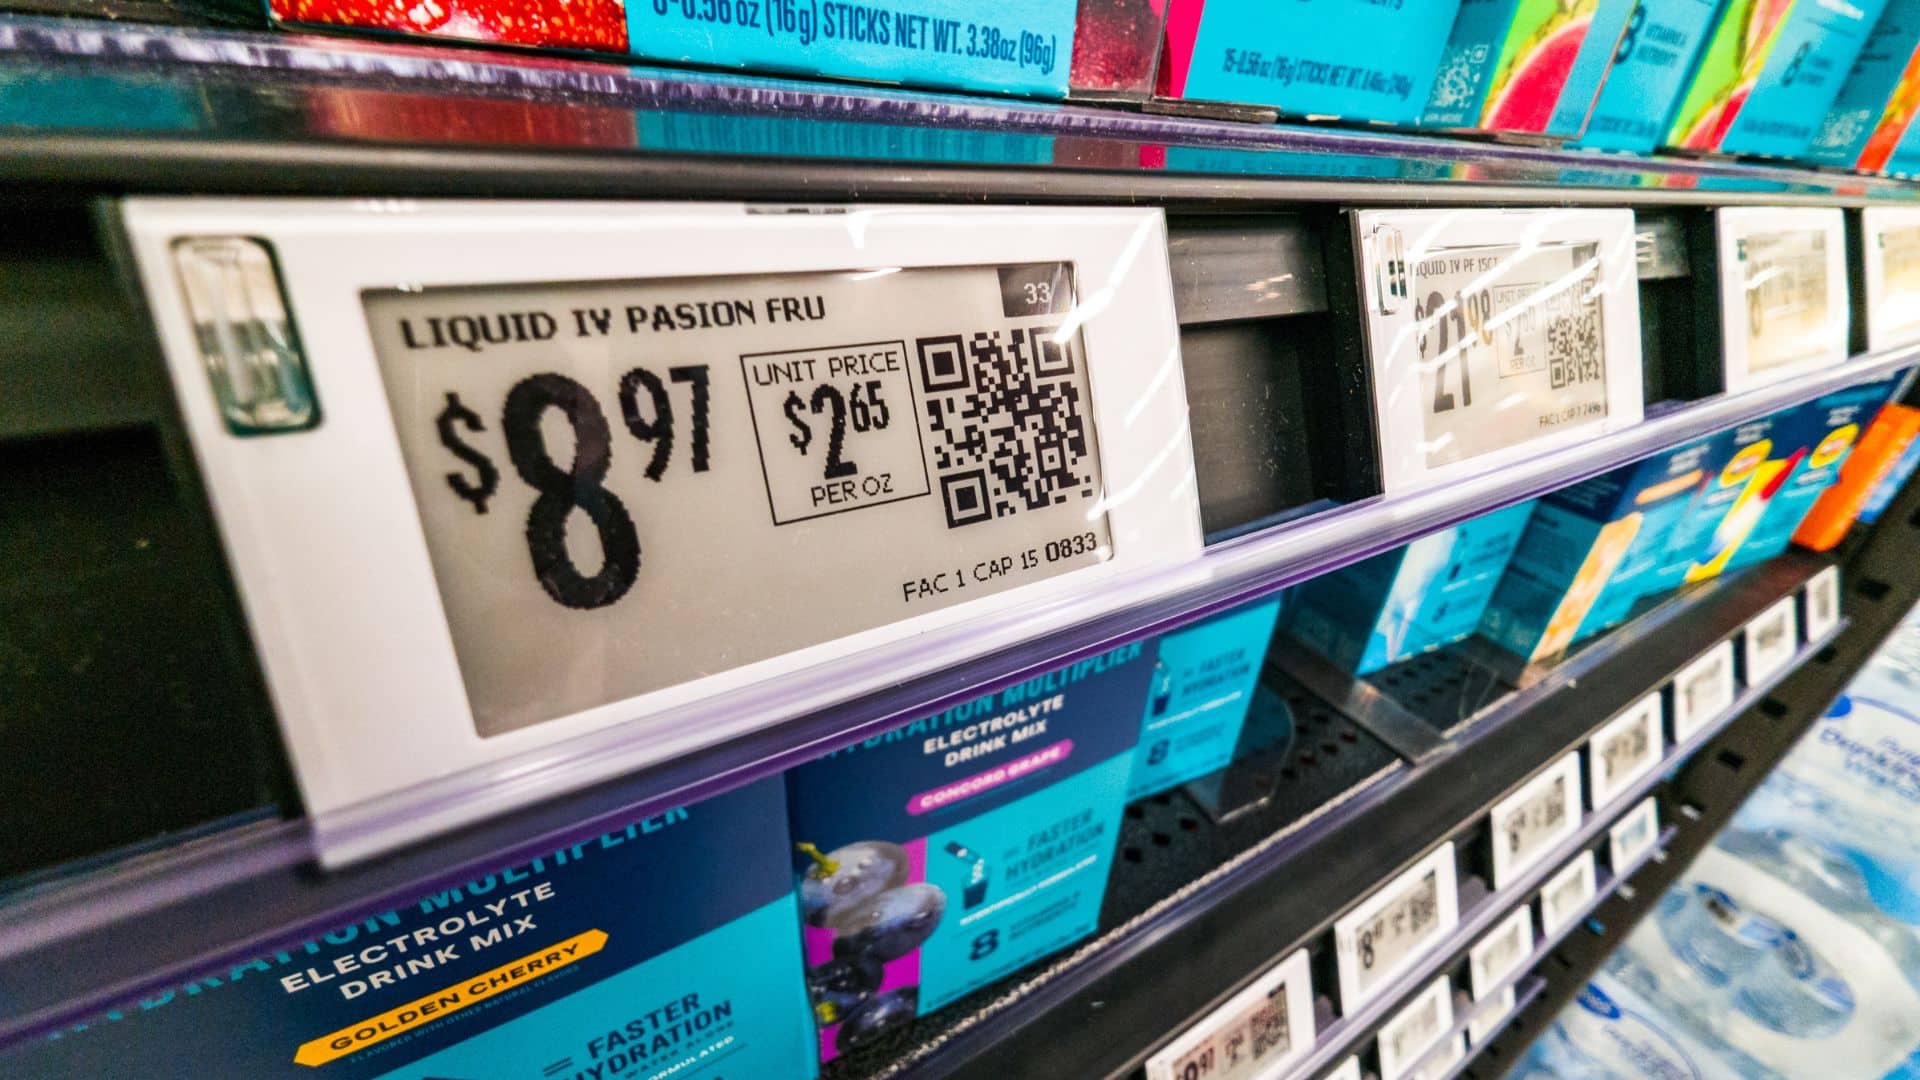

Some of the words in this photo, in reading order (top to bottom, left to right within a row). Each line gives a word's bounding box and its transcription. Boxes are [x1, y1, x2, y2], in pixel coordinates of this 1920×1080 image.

[735, 0, 760, 28] oz
[766, 0, 818, 45] (16g)
[823, 2, 890, 45] STICKS
[895, 12, 929, 50] NET
[933, 18, 962, 54] WT.
[966, 24, 1016, 61] 3.38oz
[1019, 30, 1057, 75] (96g)
[1023, 282, 1051, 305] 33
[1449, 260, 1460, 274] IV
[1463, 257, 1475, 272] PF
[399, 311, 558, 352] LIQUID
[572, 308, 612, 337] IV
[626, 300, 756, 334] PASION
[766, 296, 826, 324] FRU
[752, 359, 816, 386] UNIT
[829, 351, 901, 378] PRICE
[811, 480, 858, 507] PER
[862, 474, 893, 495] OZ
[903, 573, 947, 602] FAC
[957, 569, 967, 588] 1
[973, 556, 1013, 583] CAP
[1021, 550, 1040, 570] 15
[1045, 532, 1098, 562] 0833
[923, 694, 1065, 754] ELECTROLYTE
[944, 734, 1007, 768] DRINK
[1011, 719, 1047, 743] MIX
[280, 881, 556, 993] ELECTROLYTE
[339, 944, 461, 1000] DRINK
[470, 914, 537, 951] MIX
[969, 929, 999, 961] 8
[329, 992, 461, 1051] GOLDEN
[468, 943, 580, 996] CHERRY
[586, 993, 700, 1060] FASTER
[571, 1000, 733, 1080] YDRATION
